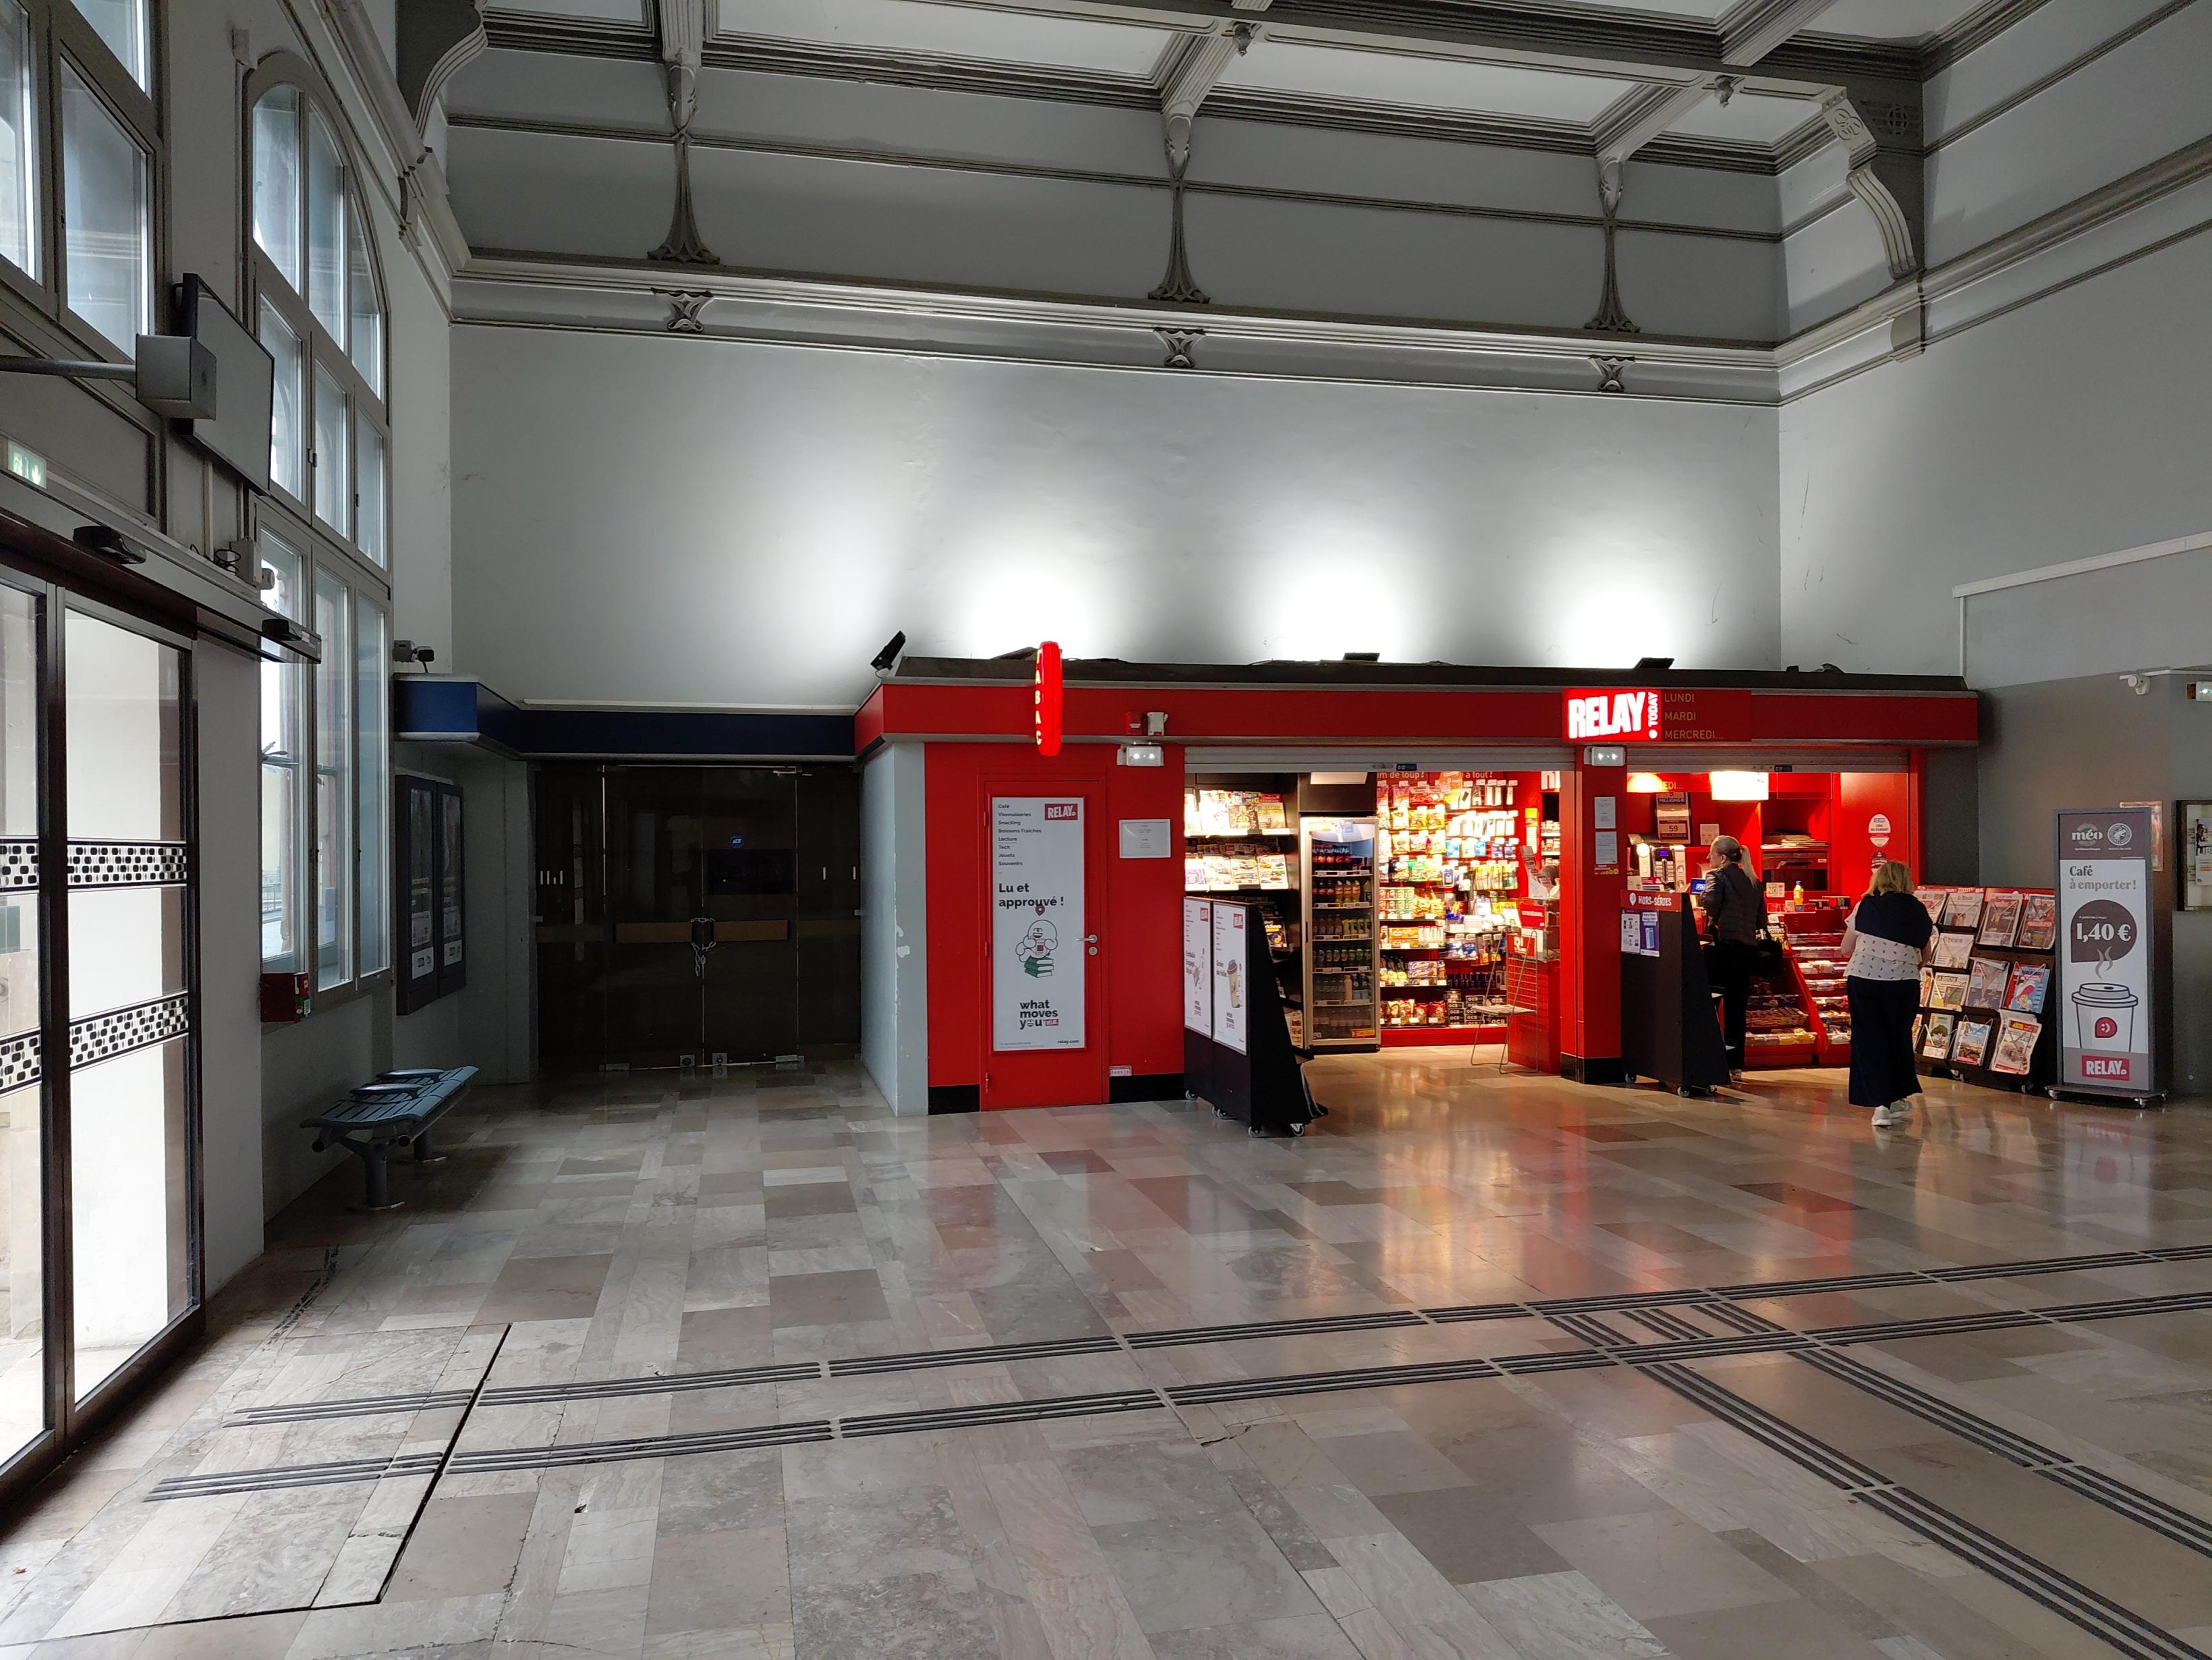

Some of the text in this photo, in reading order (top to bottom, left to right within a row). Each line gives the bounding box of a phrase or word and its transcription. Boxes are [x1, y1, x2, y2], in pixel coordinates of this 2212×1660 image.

[1664, 694, 1695, 702] LUNDI
[1647, 691, 1658, 727] TODAY
[1568, 691, 1646, 739] RELAY
[1664, 712, 1696, 721] MARDI
[1664, 730, 1724, 740] MERCREDI...
[1048, 805, 1073, 819] RELAY
[2072, 829, 2103, 841] méo
[2070, 865, 2094, 877] Café
[998, 883, 1029, 893] Lu et
[2070, 878, 2076, 889] à
[998, 896, 1057, 909] approuvé
[1638, 895, 1672, 906] HORS-SÉRIES
[2076, 922, 2114, 943] 1,40
[1020, 999, 1050, 1009] what
[1020, 1009, 1058, 1018] moves
[2086, 1060, 2123, 1075] RELAY
